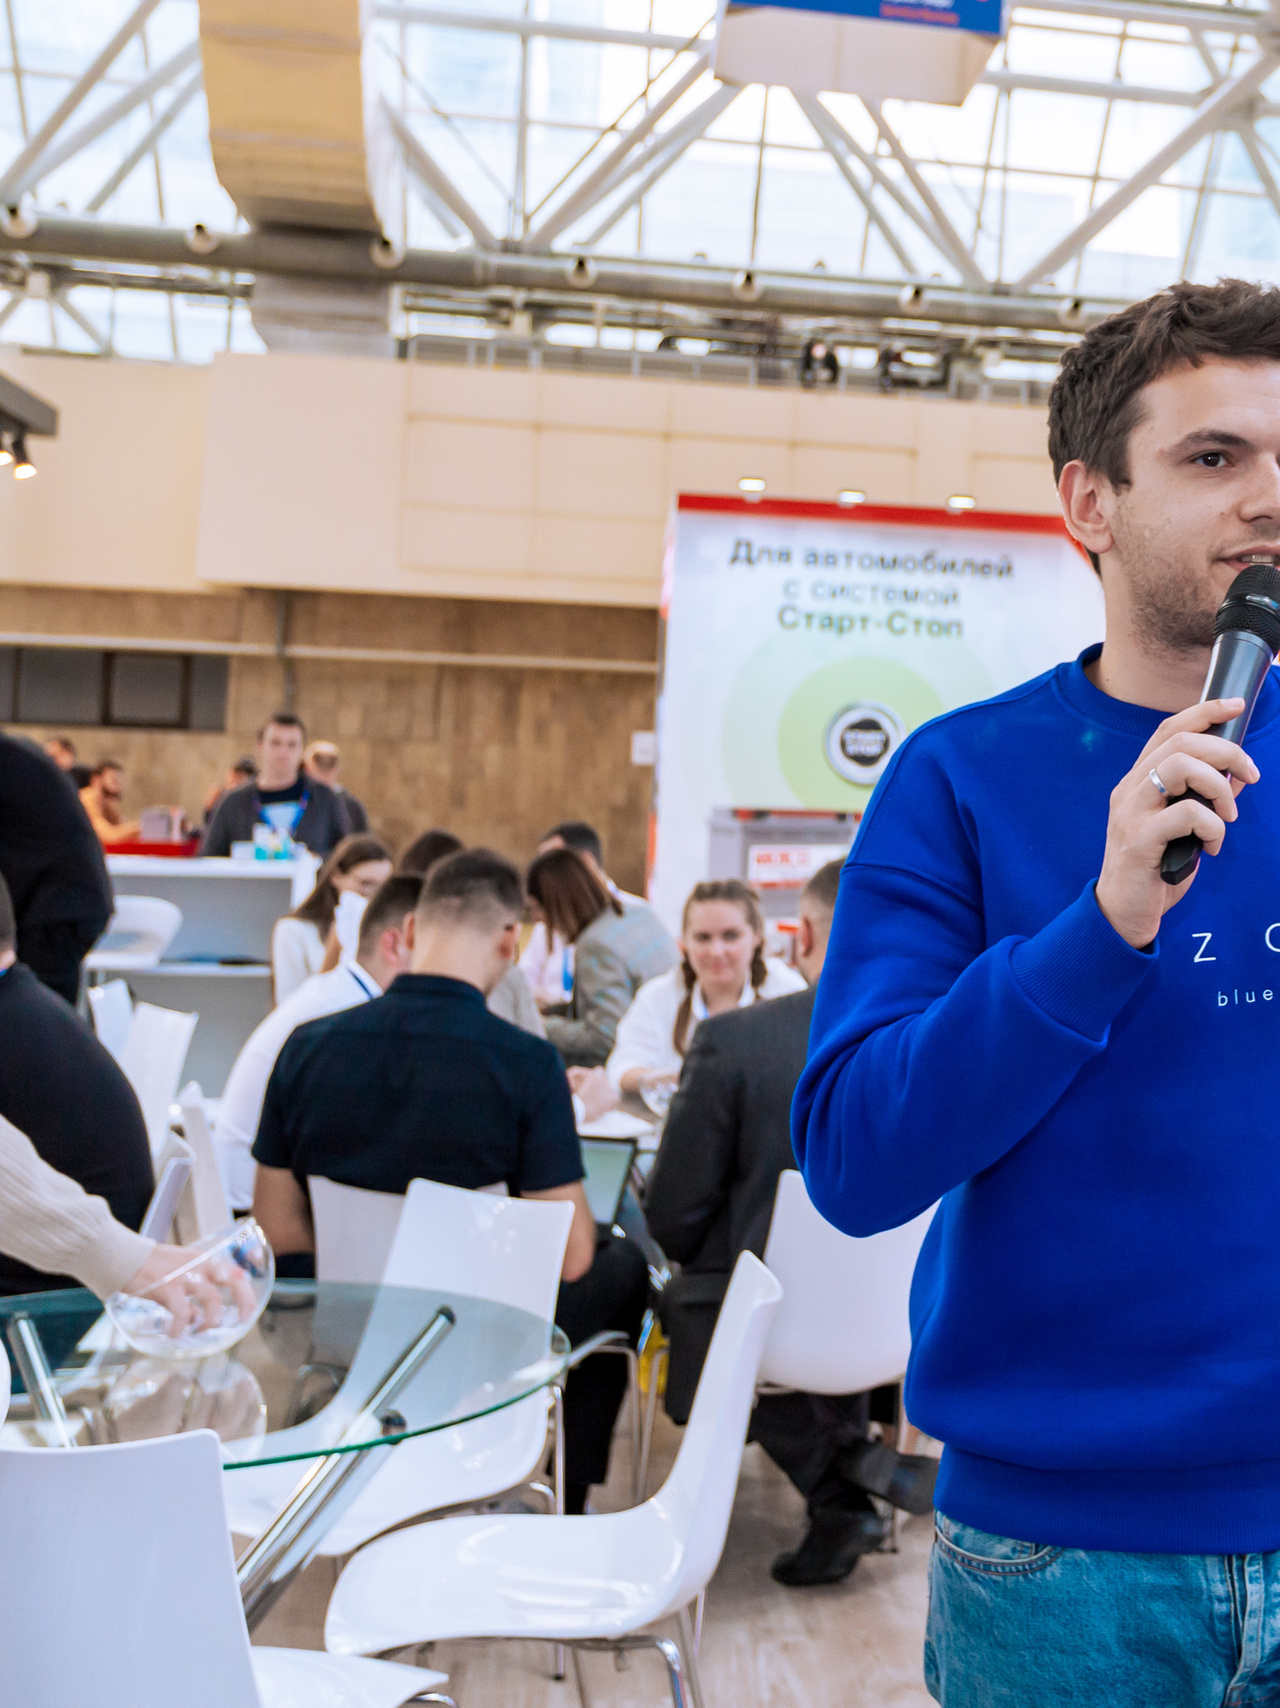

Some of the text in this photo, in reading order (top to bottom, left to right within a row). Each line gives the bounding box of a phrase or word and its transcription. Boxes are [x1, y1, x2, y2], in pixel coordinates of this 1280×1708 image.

[729, 538, 1014, 579] Для автомобилей
[783, 579, 960, 607] с системой
[777, 605, 964, 638] Старт-Стоп
[1217, 988, 1275, 1007] blue
